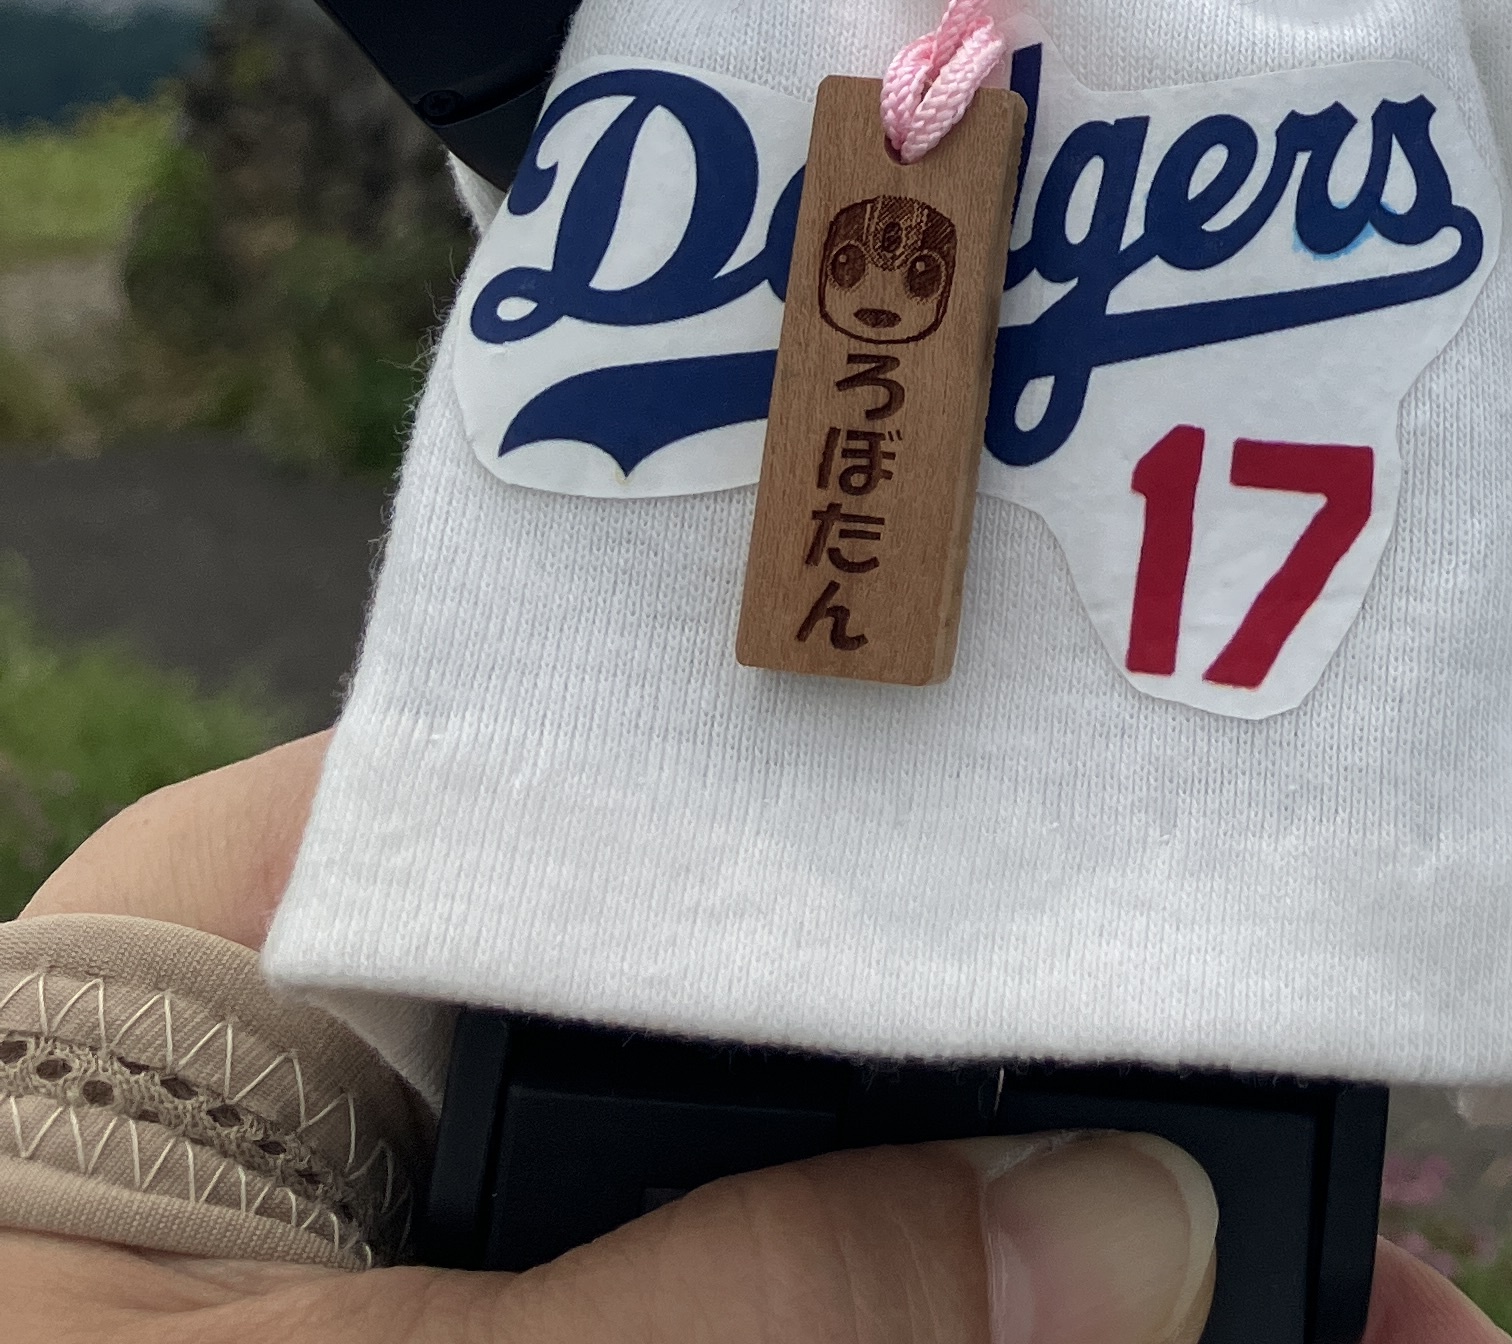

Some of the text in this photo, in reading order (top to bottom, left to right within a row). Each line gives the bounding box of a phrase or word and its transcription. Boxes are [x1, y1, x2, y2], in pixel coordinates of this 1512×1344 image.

[471, 43, 1483, 467] Dgers
[794, 351, 906, 652] ろぼたん
[1127, 425, 1374, 689] 17
